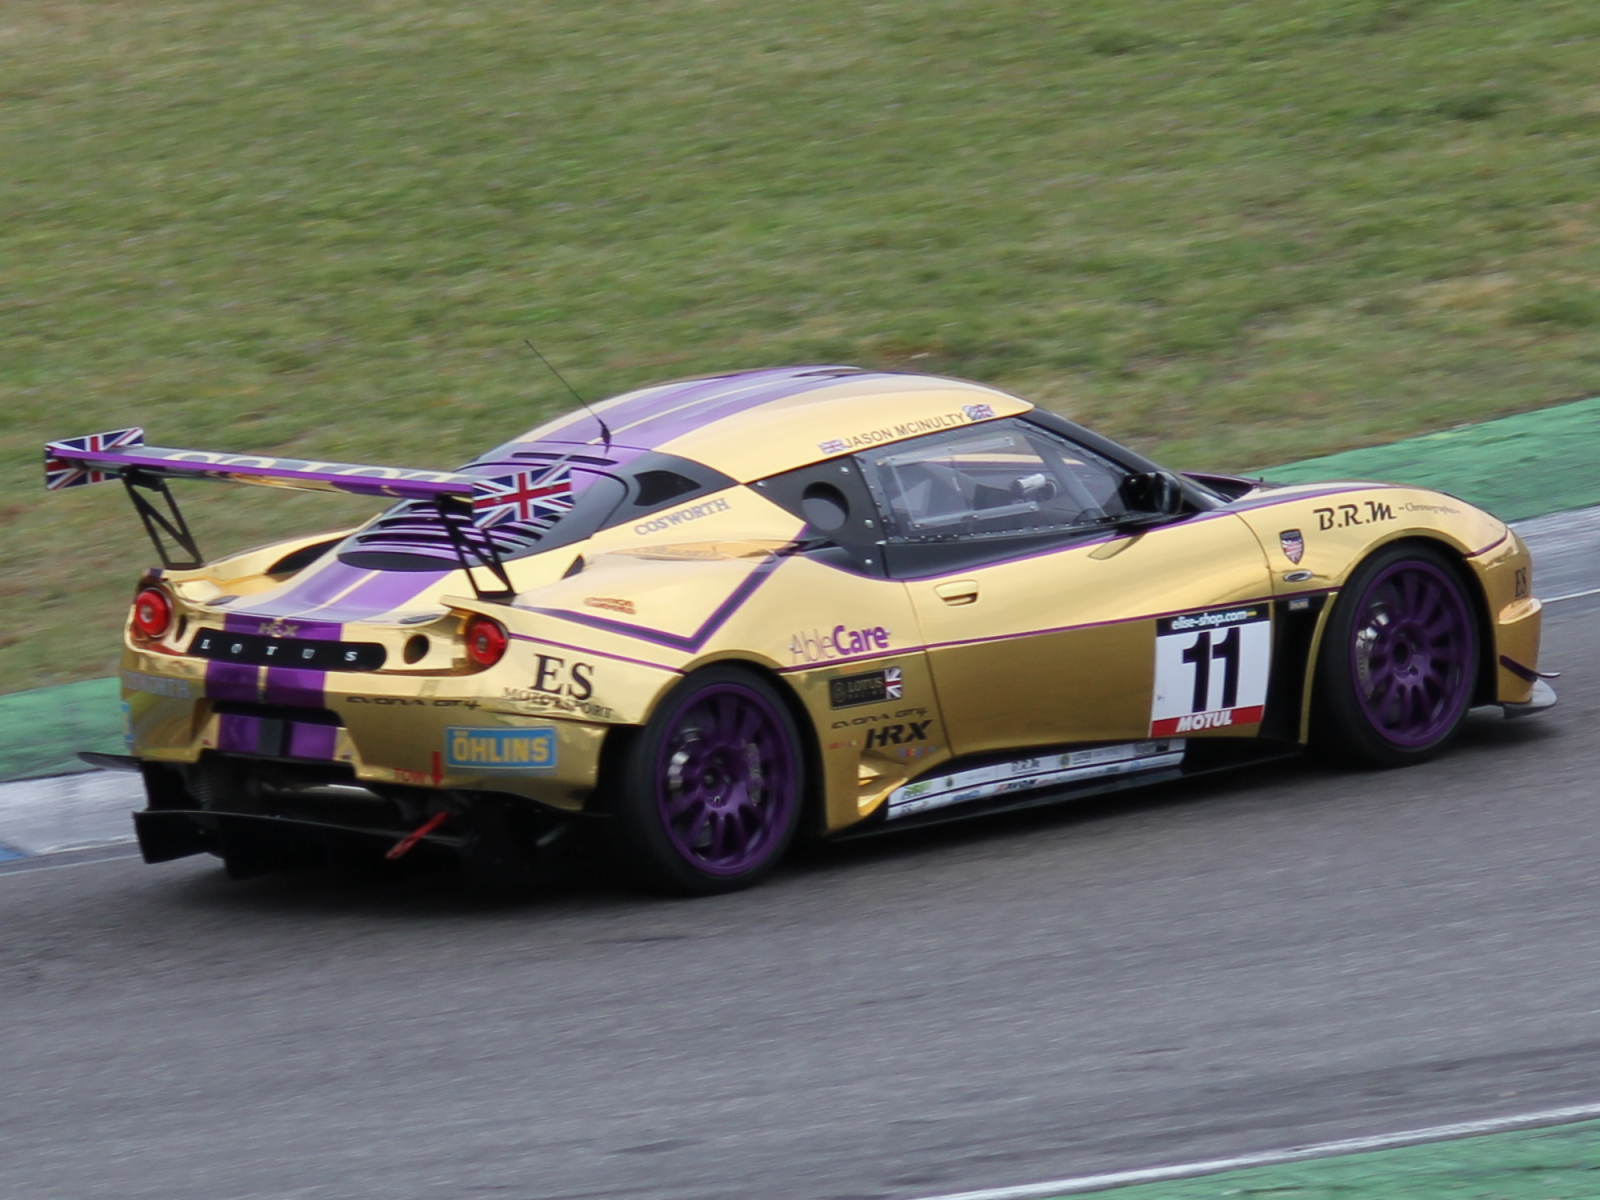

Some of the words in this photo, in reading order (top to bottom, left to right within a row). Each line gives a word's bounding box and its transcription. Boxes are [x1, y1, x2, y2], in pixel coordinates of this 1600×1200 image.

[845, 428, 893, 449] JASON
[893, 412, 966, 437] MCINULTY
[634, 498, 731, 535] COSWORTH
[1171, 611, 1248, 630] elise-shop.com
[200, 639, 358, 662] LOTUS
[790, 625, 890, 664] AbleCare
[530, 654, 595, 700] ES
[1182, 627, 1240, 713] 11
[865, 719, 933, 750] HRX
[1175, 710, 1233, 733] MOTUL
[453, 730, 549, 763] ÖHLINS
